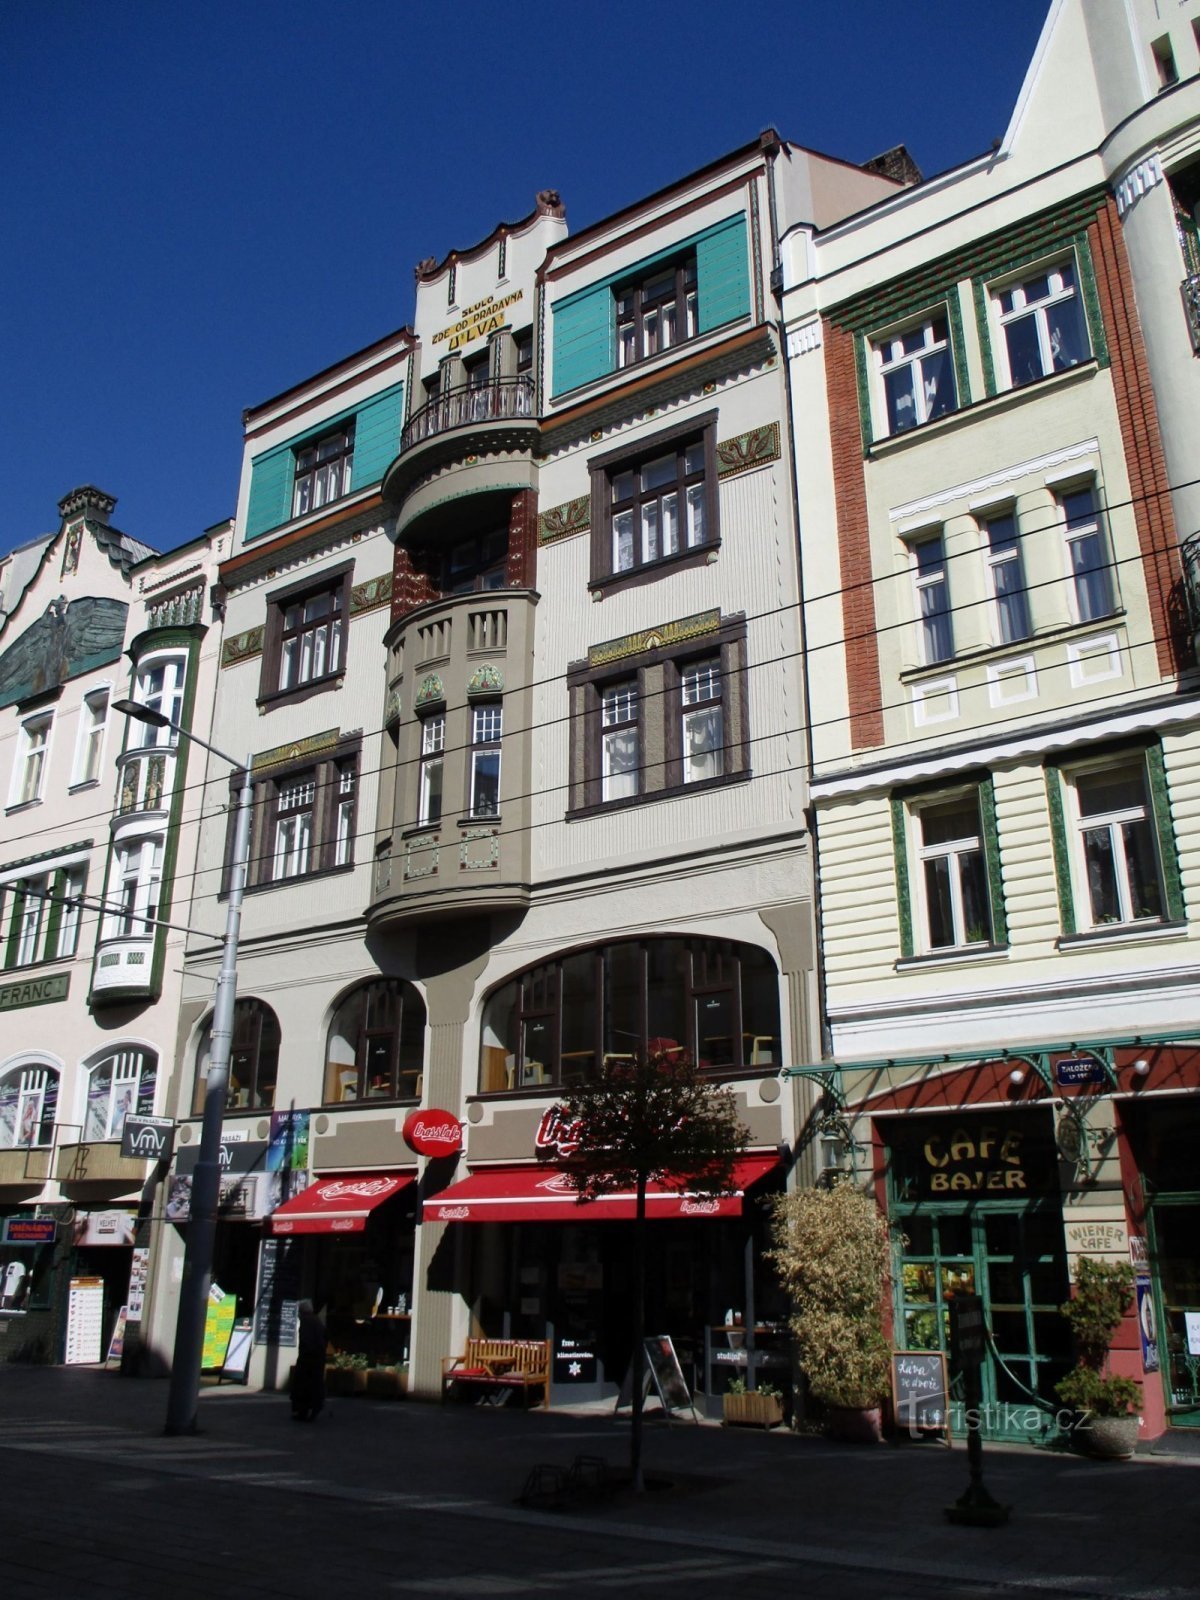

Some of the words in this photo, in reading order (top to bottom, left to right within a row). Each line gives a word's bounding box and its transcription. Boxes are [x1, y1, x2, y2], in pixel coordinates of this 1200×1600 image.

[461, 294, 494, 318] SLULO
[432, 328, 453, 345] ZDE
[455, 319, 468, 333] OD
[930, 1170, 1027, 1191] BAJER
[1069, 1225, 1124, 1242] WIENER
[1080, 1237, 1112, 1249] CAFE
